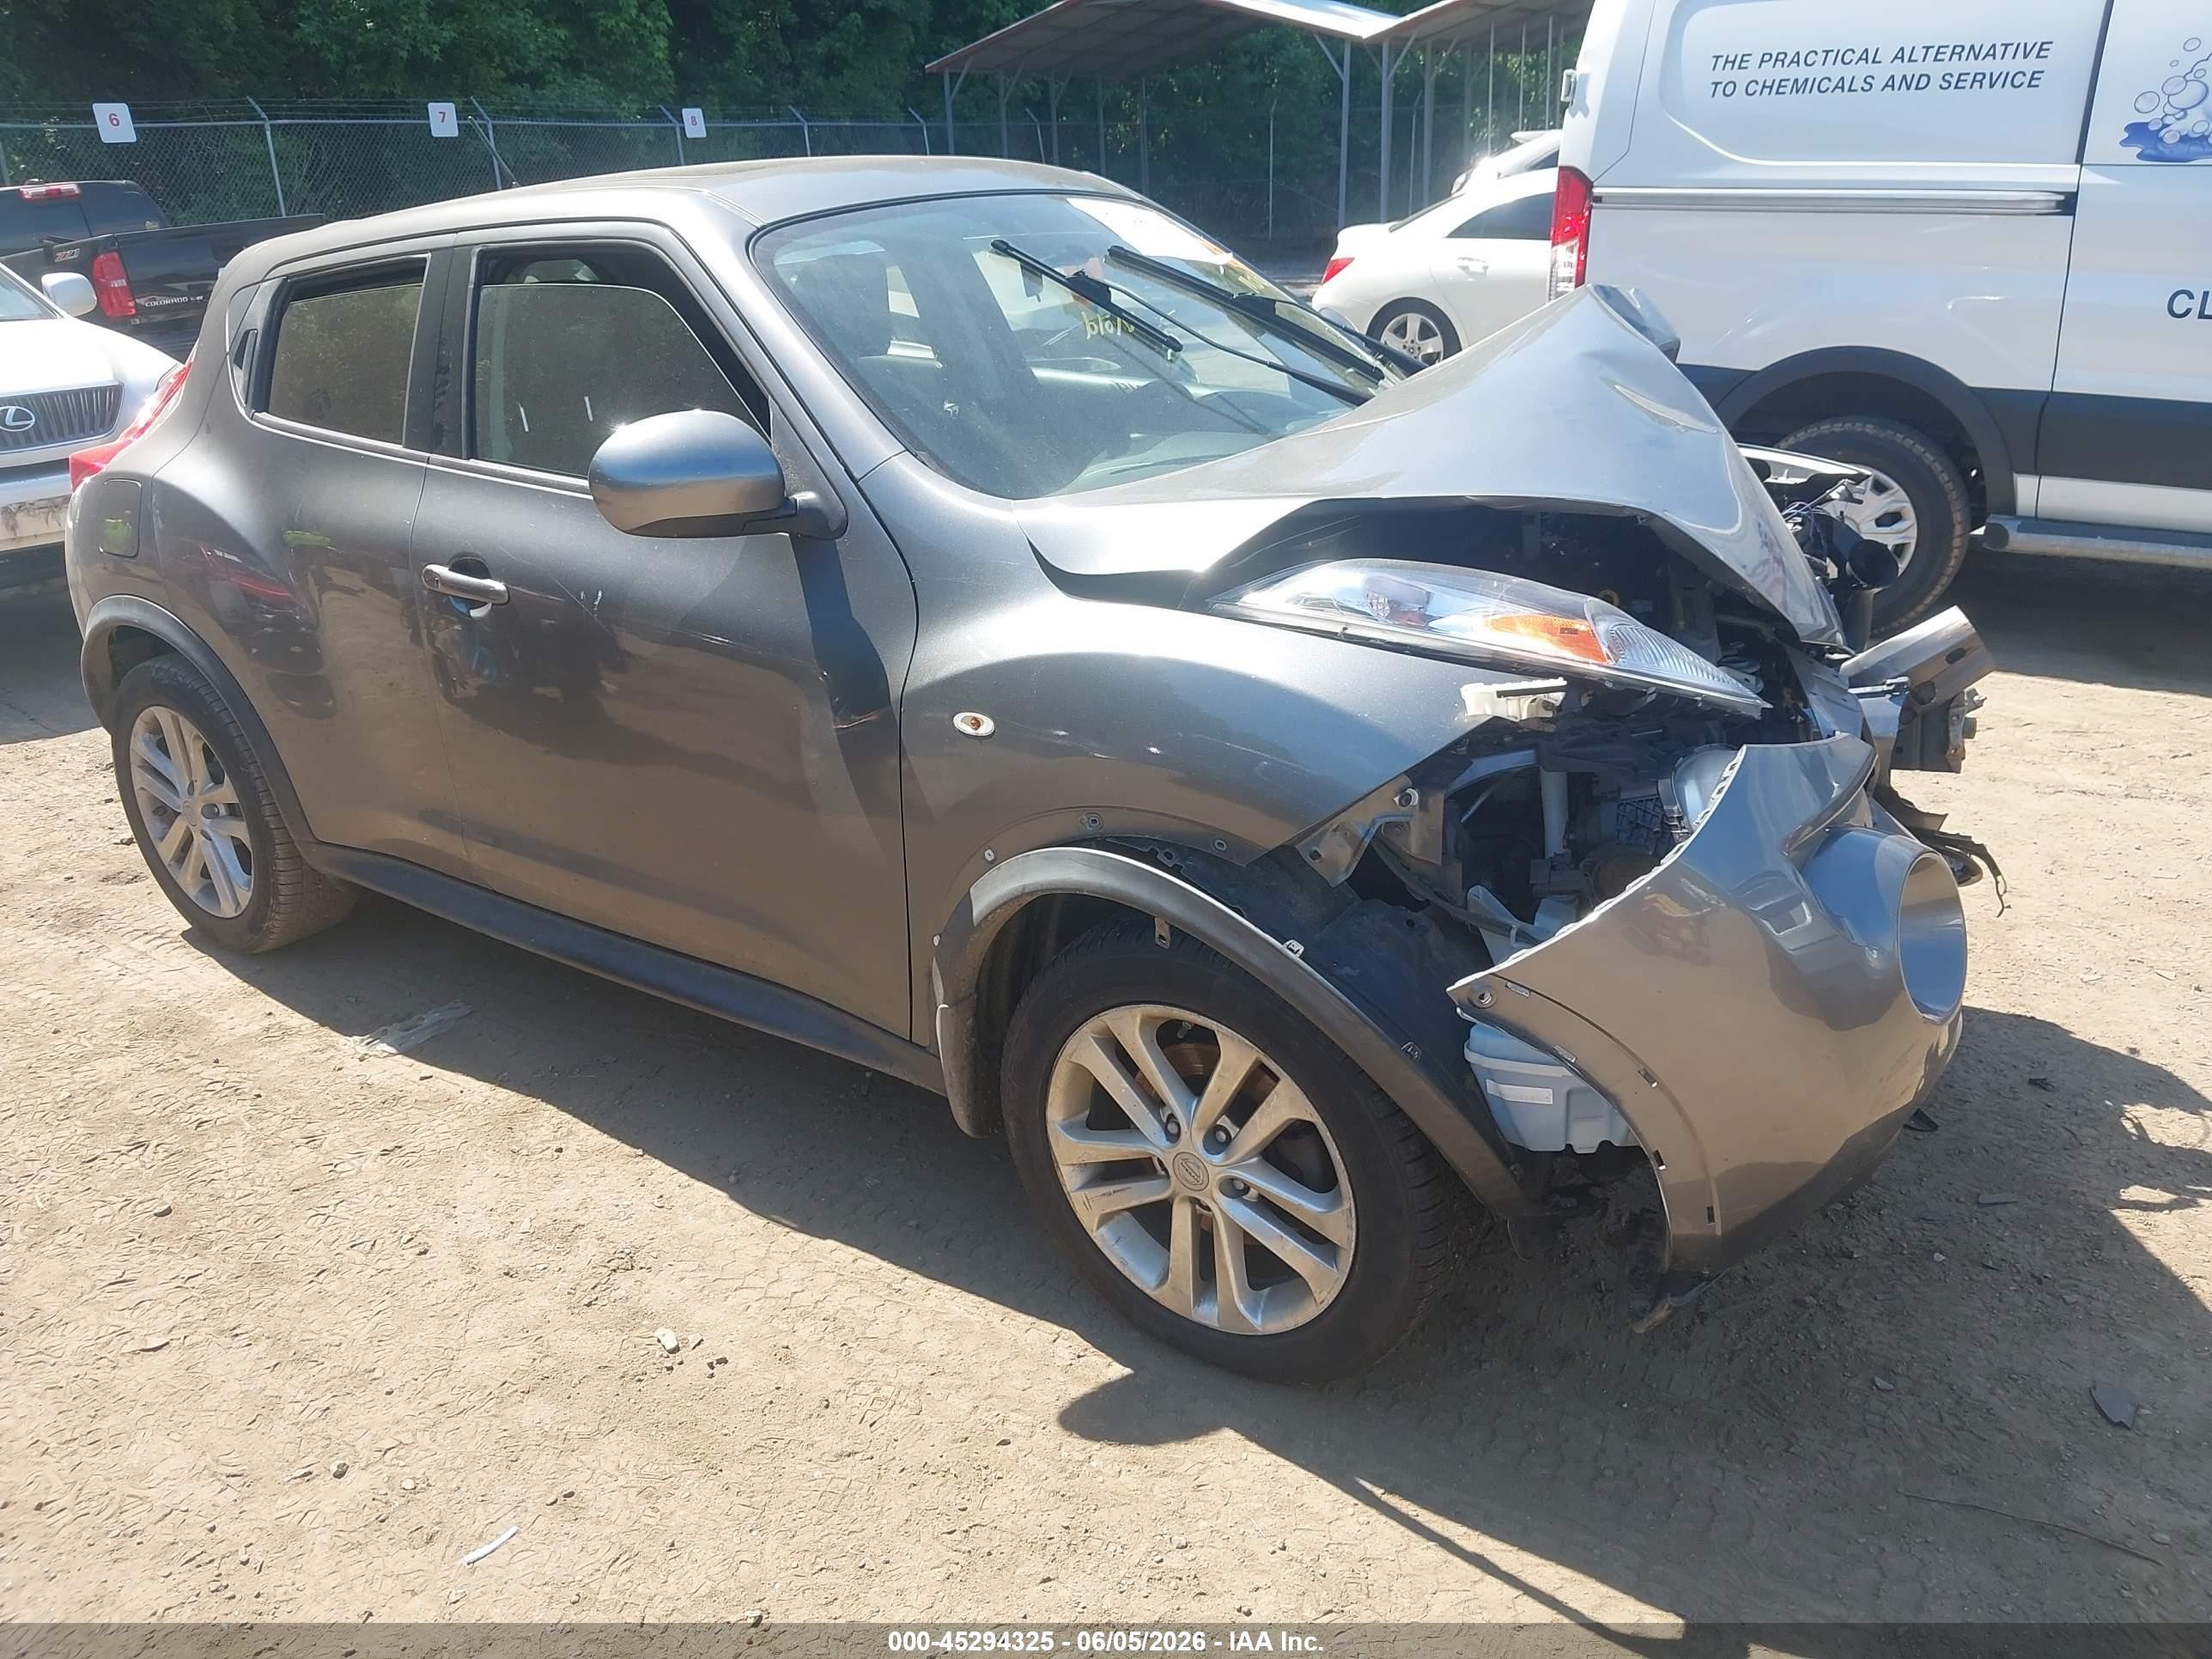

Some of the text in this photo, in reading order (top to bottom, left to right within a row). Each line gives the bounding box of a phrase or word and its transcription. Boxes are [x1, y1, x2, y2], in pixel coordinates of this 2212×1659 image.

[1711, 40, 2054, 71] THE PRACTICAL ALTERNATIVE
[1711, 70, 2045, 99] TO CHEMICALS AND SERVICE
[108, 112, 120, 127] 6
[438, 111, 447, 123] 7
[690, 115, 697, 126] 8
[145, 295, 188, 307] COLORADO
